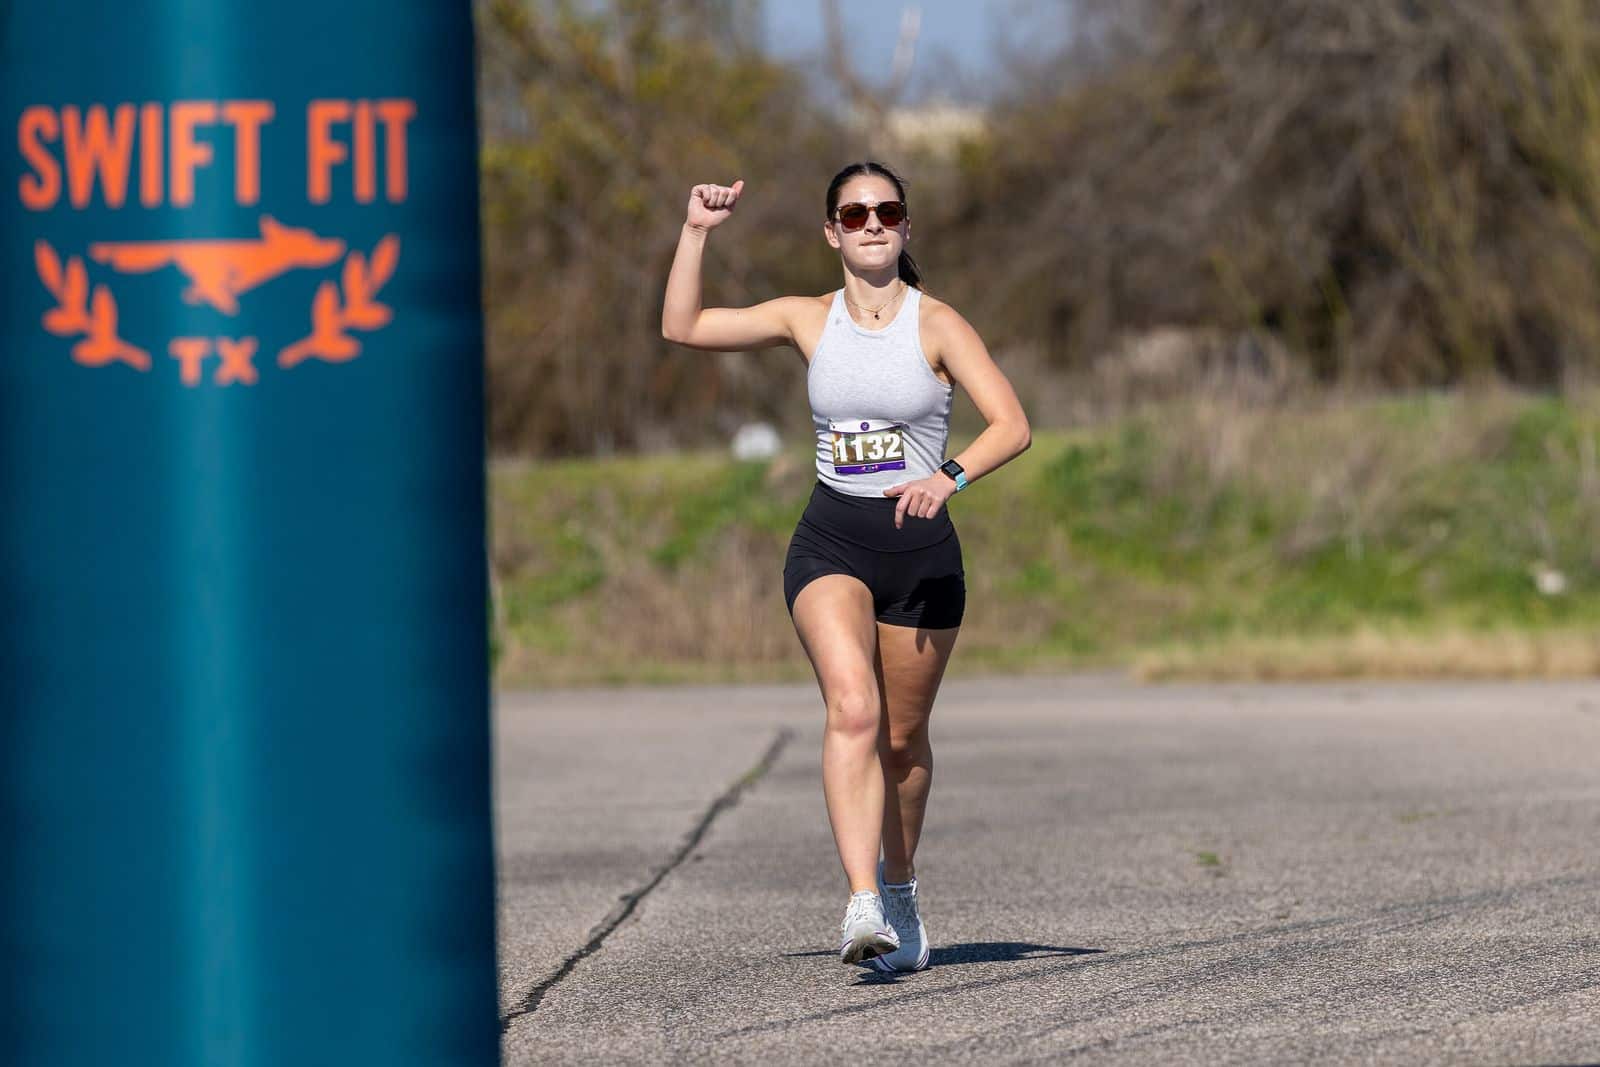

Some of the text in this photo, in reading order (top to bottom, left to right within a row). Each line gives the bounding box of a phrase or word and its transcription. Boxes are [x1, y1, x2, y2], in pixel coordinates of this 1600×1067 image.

[18, 97, 416, 211] SWIFT FIT
[168, 336, 258, 387] TX
[835, 433, 902, 462] 1132
